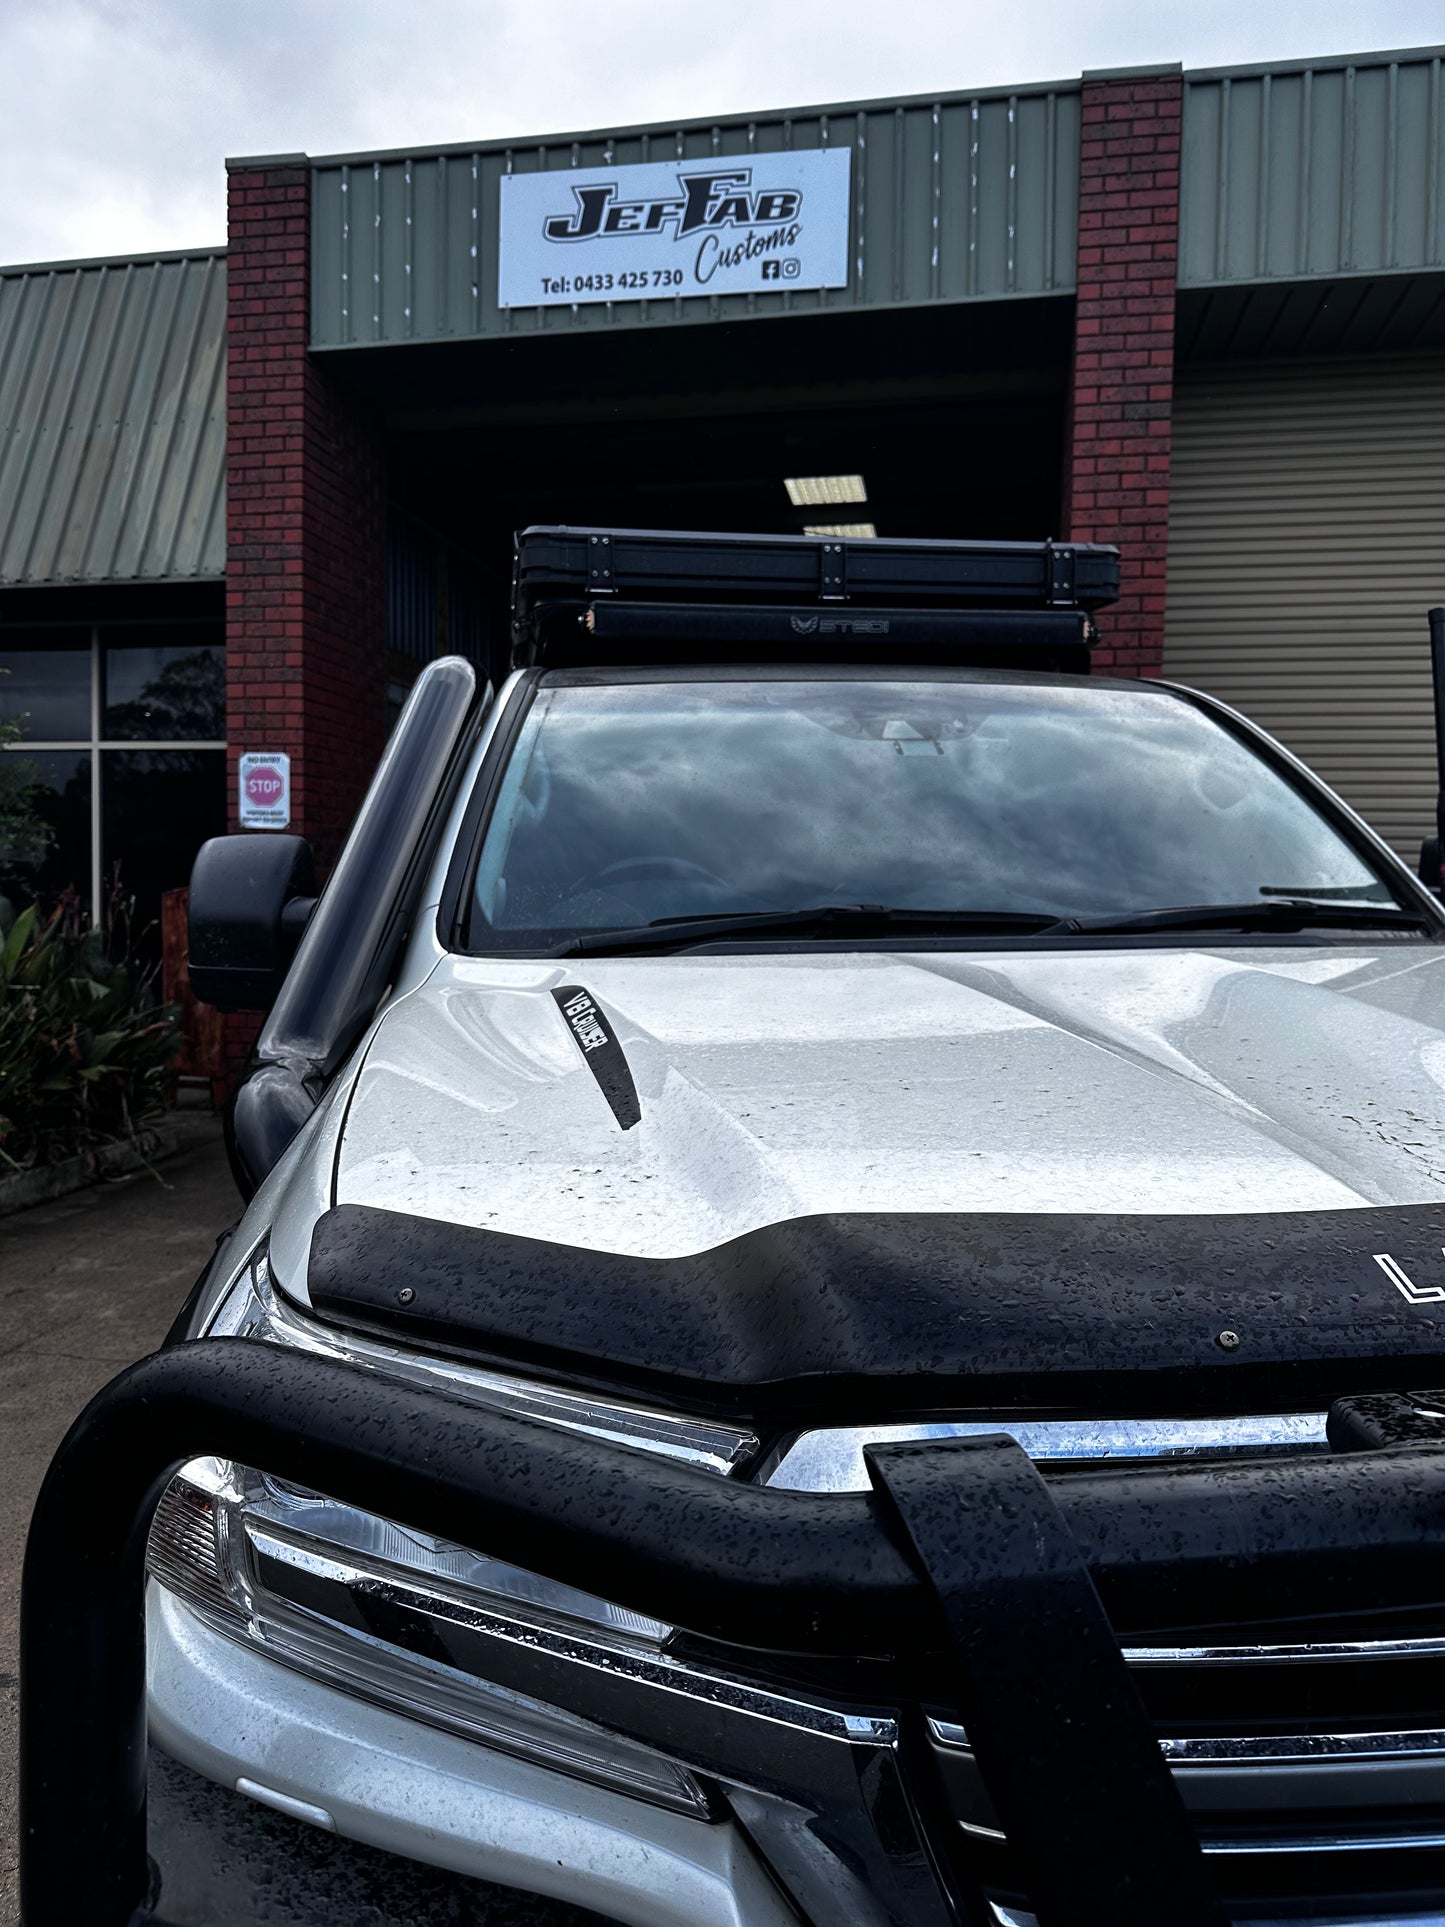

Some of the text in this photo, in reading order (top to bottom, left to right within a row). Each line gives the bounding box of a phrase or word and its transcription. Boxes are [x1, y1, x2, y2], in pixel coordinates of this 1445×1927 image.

[694, 223, 803, 284] Customs
[541, 269, 684, 294] Tel: 0433 425 730
[249, 779, 280, 794] STOP
[1372, 1247, 1445, 1305] L
